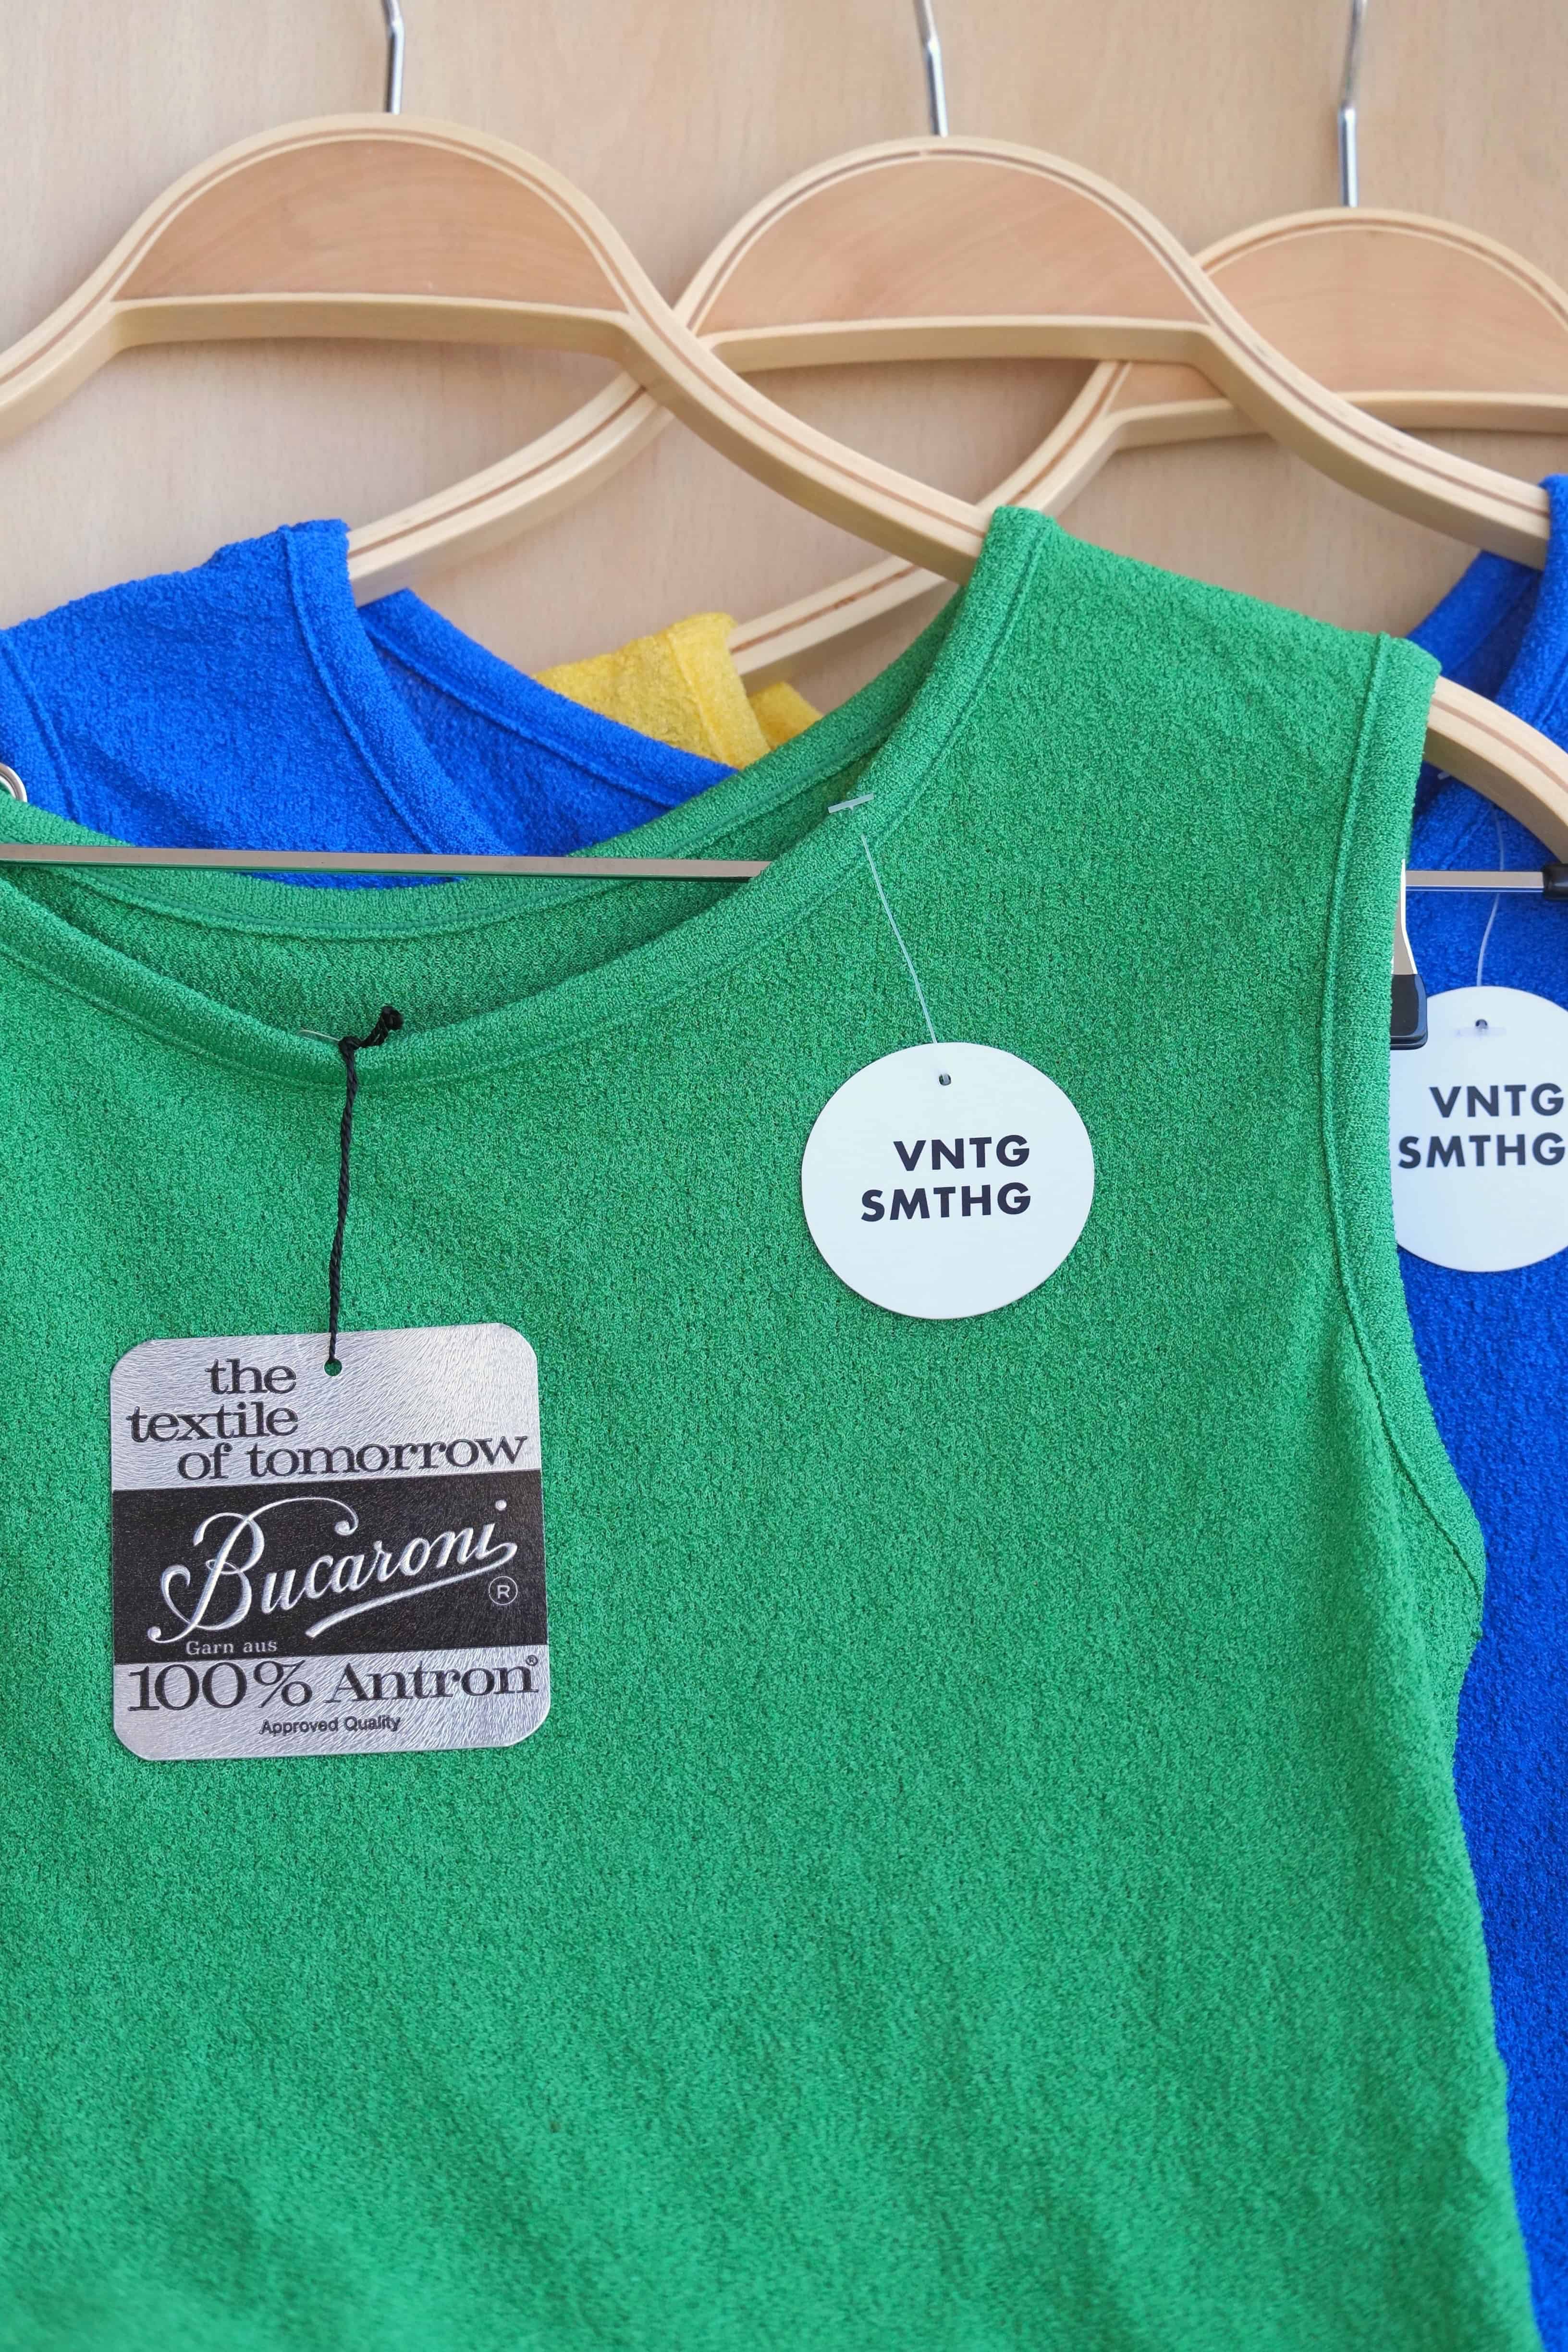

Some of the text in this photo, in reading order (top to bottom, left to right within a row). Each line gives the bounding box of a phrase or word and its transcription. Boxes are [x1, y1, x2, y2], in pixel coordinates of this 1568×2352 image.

[1429, 1083, 1564, 1118] VNTG
[893, 1134, 1030, 1172] VNTG
[1397, 1132, 1566, 1169] SMTHG
[860, 1182, 1031, 1222] SMTHG
[205, 1358, 297, 1395] the
[127, 1402, 298, 1442] textile
[177, 1435, 528, 1481] of tomorrow
[147, 1497, 518, 1643] Bucaroni
[186, 1639, 278, 1655] Garn aus
[127, 1659, 314, 1712] 100%
[259, 1714, 401, 1735] Approved Quality
